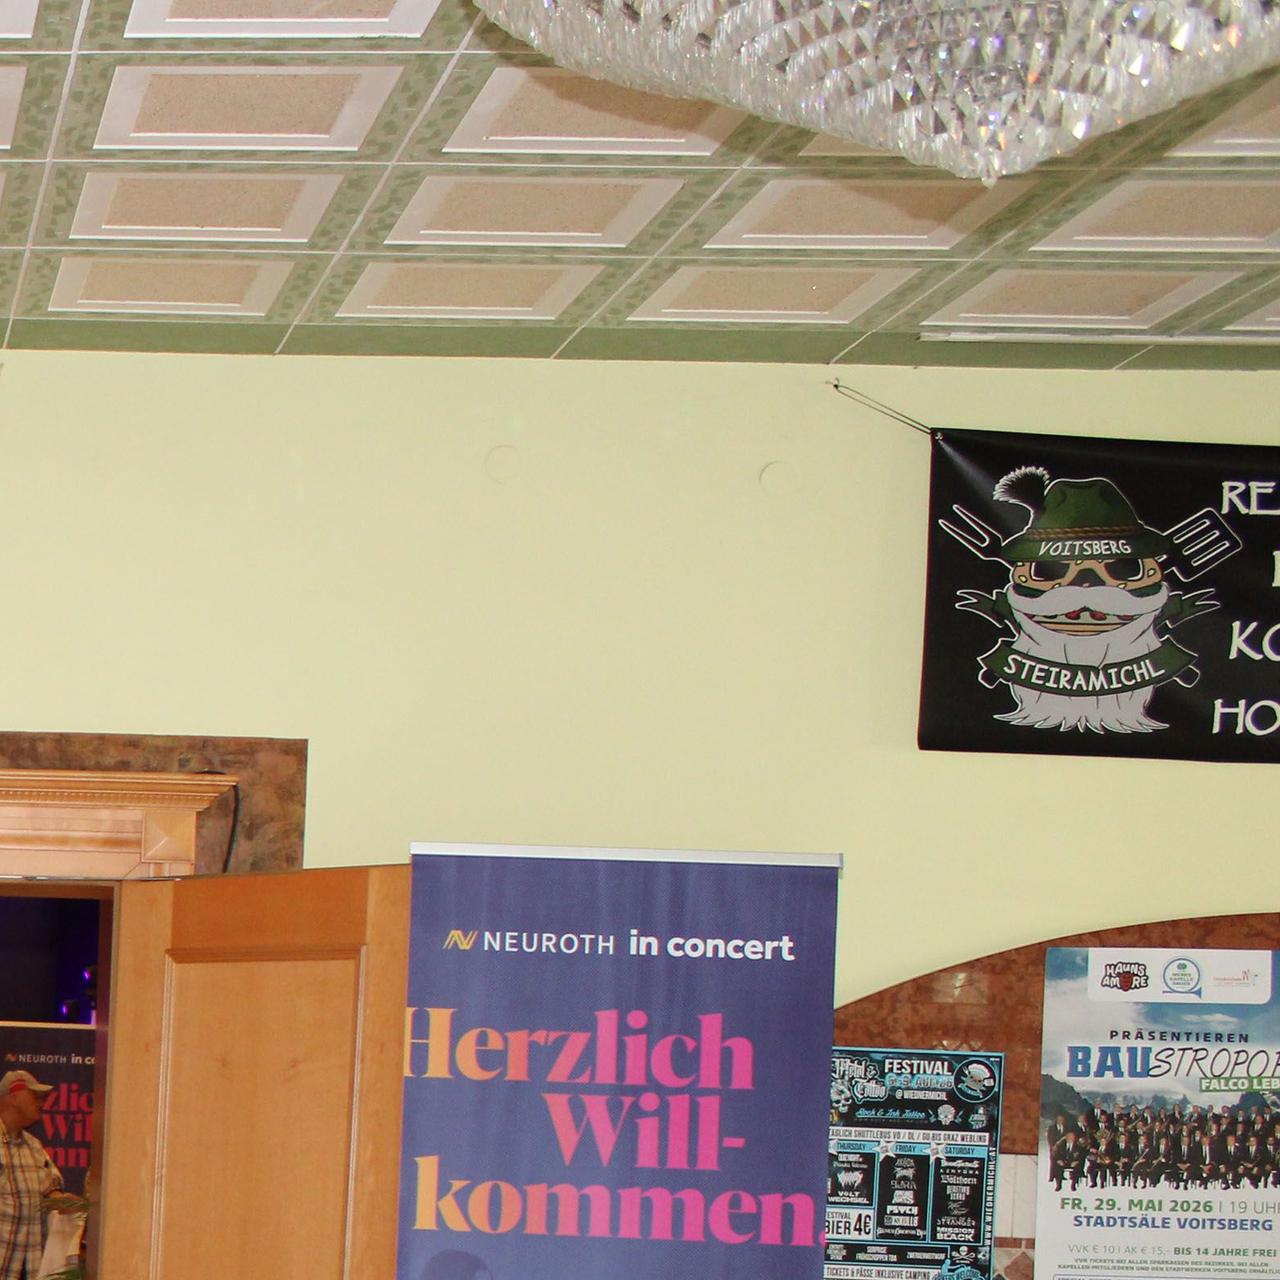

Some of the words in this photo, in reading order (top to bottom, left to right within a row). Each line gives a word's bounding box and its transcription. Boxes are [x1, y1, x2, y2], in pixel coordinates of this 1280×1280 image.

[1038, 539, 1132, 557] VOITSBERG
[1003, 654, 1166, 691] STEIRAMICHL
[483, 930, 615, 956] NEUROTH
[629, 928, 658, 957] in
[666, 935, 796, 962] concert
[1106, 961, 1146, 977] HAUNS
[1109, 1027, 1249, 1043] PRÄSENTIEREN
[403, 1006, 755, 1090] Herzlich
[18, 1053, 67, 1064] NEUROTH
[71, 1053, 82, 1065] in
[884, 1059, 952, 1075] FESTIVAL
[1201, 1078, 1249, 1090] FALCO
[541, 1091, 747, 1172] Will-
[853, 1130, 891, 1139] SHUTTLEBUS
[943, 1133, 959, 1142] GRAZ
[960, 1134, 987, 1143] WEBLING
[837, 1142, 866, 1151] THURSDAY
[895, 1144, 916, 1153] FRIDAY
[945, 1147, 975, 1155] SATURDAY
[1060, 1197, 1088, 1212] FR,
[1094, 1198, 1122, 1212] 29.
[1128, 1199, 1163, 1212] MAI
[1169, 1199, 1214, 1213] 2026
[1230, 1200, 1248, 1214] 19
[1073, 1213, 1171, 1229] STADTSÄLE
[1176, 1217, 1273, 1231] VOITSBERG
[936, 1233, 974, 1242] BLACK
[1068, 1244, 1089, 1253] VVK
[1124, 1246, 1137, 1254] AK
[1173, 1247, 1192, 1255] BIS
[1212, 1248, 1249, 1257] JAHRE
[1252, 1248, 1277, 1257] FREI
[827, 1266, 850, 1276] TICKETS
[856, 1267, 873, 1278] PÄSSE
[874, 1269, 904, 1279] INKLUSIVE
[904, 1270, 930, 1280] CAMPING
